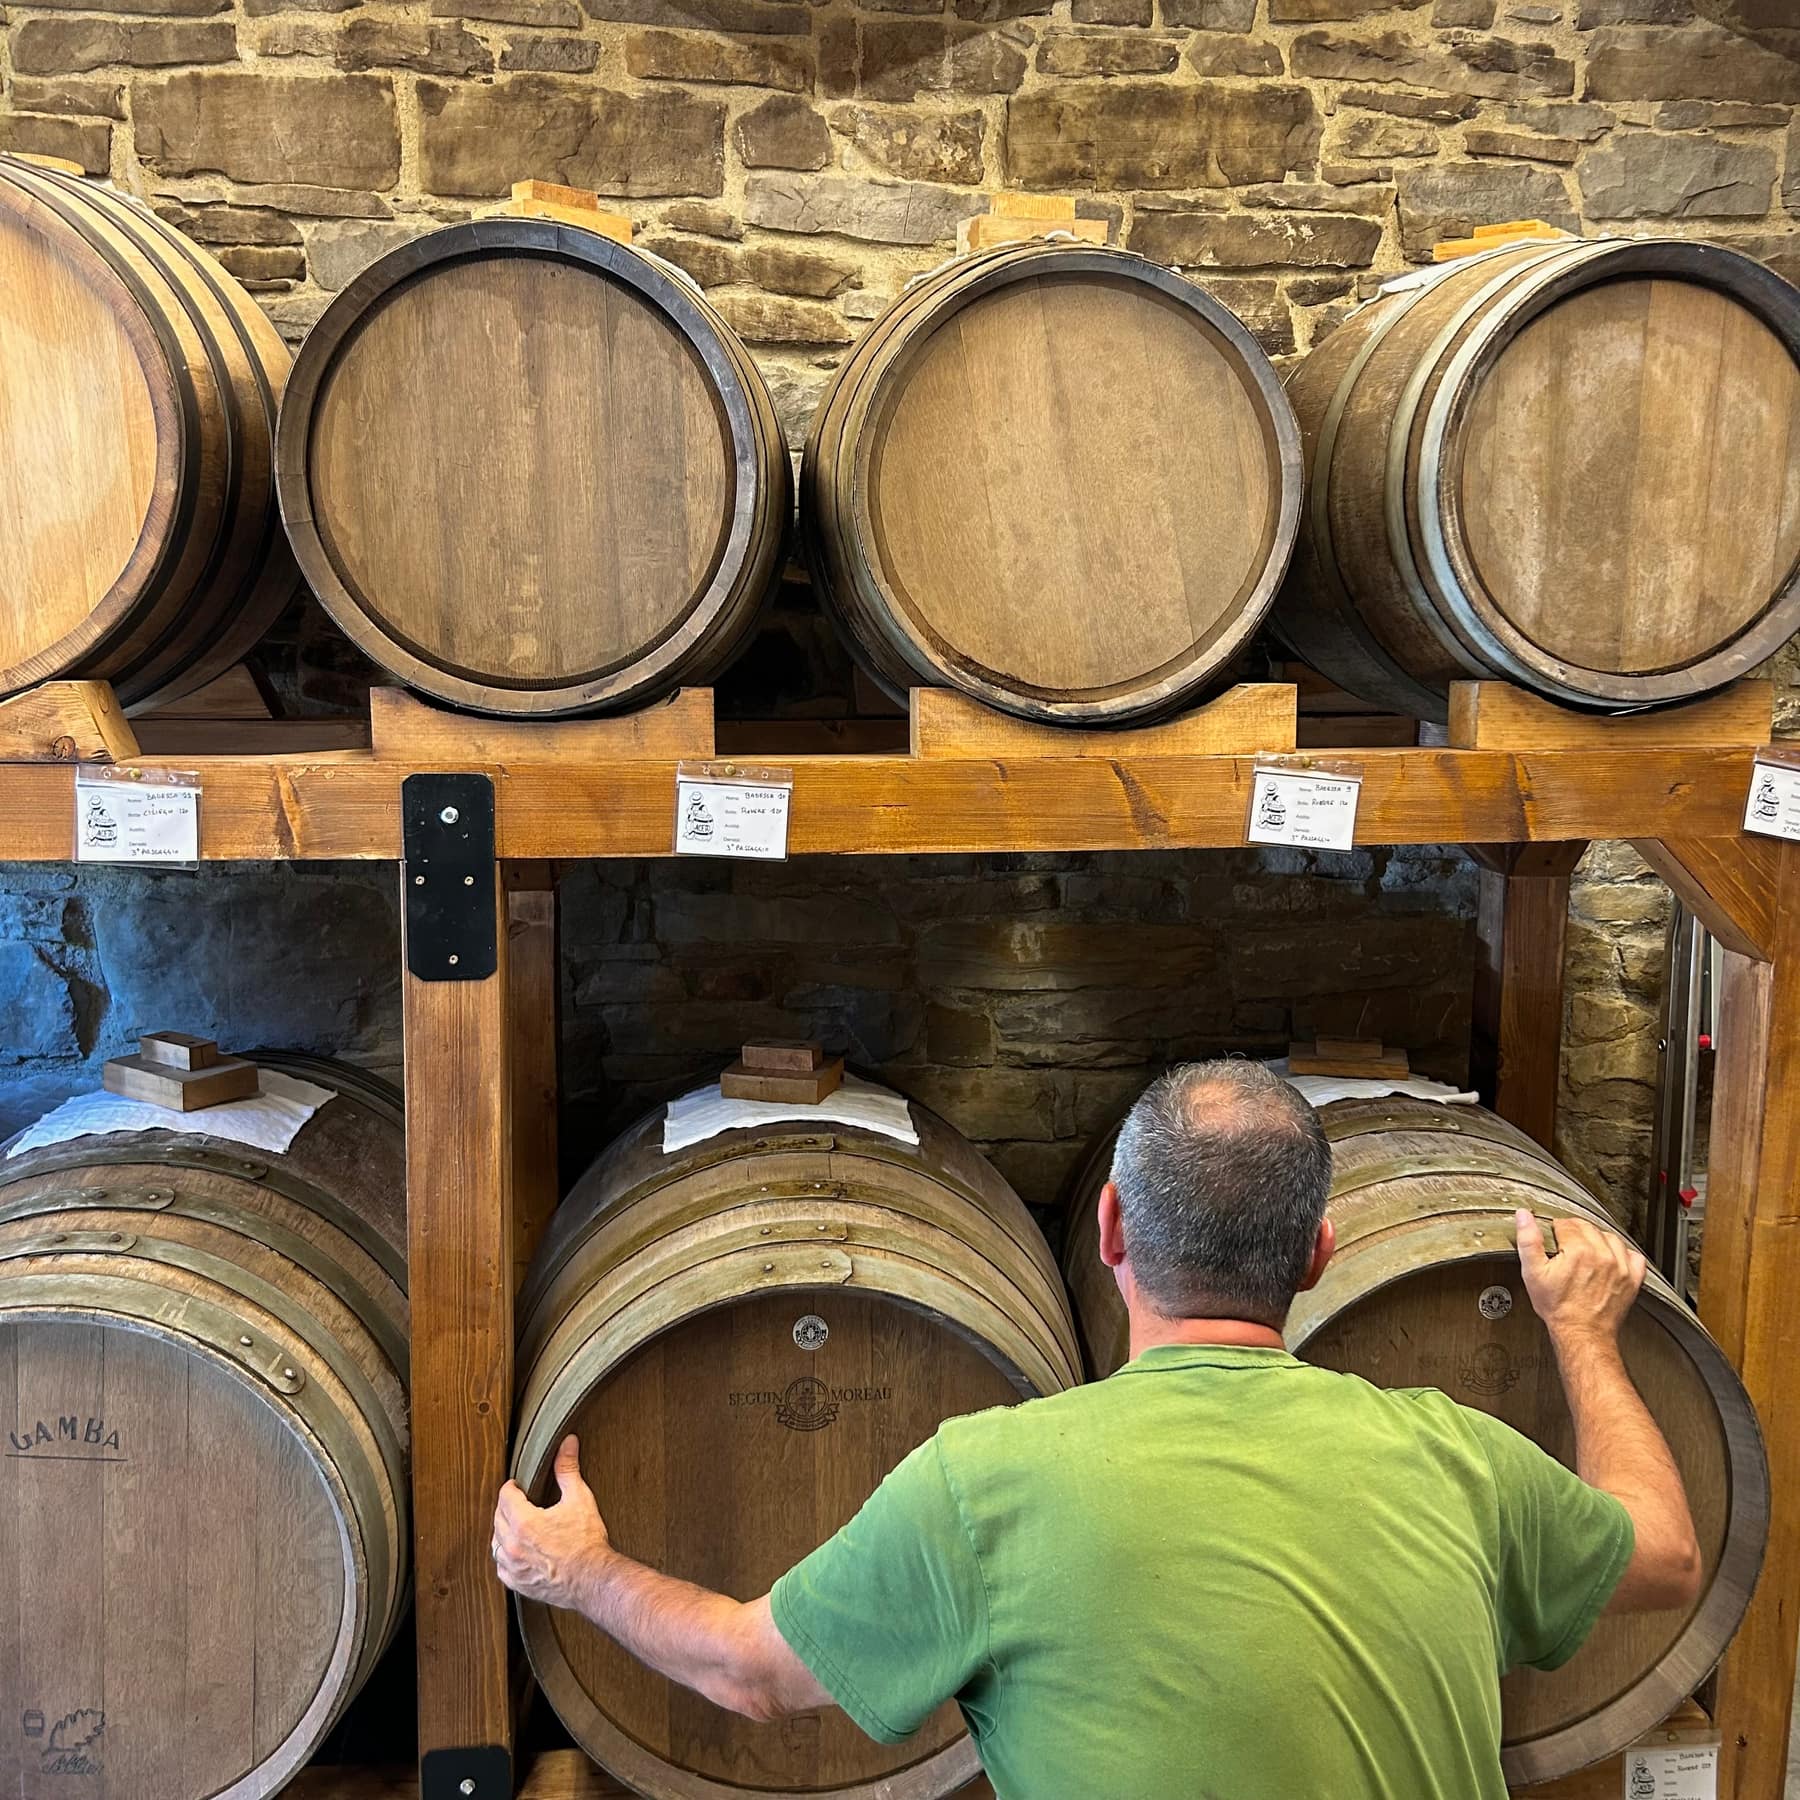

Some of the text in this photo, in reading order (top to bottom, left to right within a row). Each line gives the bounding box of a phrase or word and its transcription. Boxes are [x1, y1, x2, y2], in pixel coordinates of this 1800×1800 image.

[728, 1386, 893, 1407] SEGUIN MOREAU
[9, 1415, 120, 1451] GAMBA
